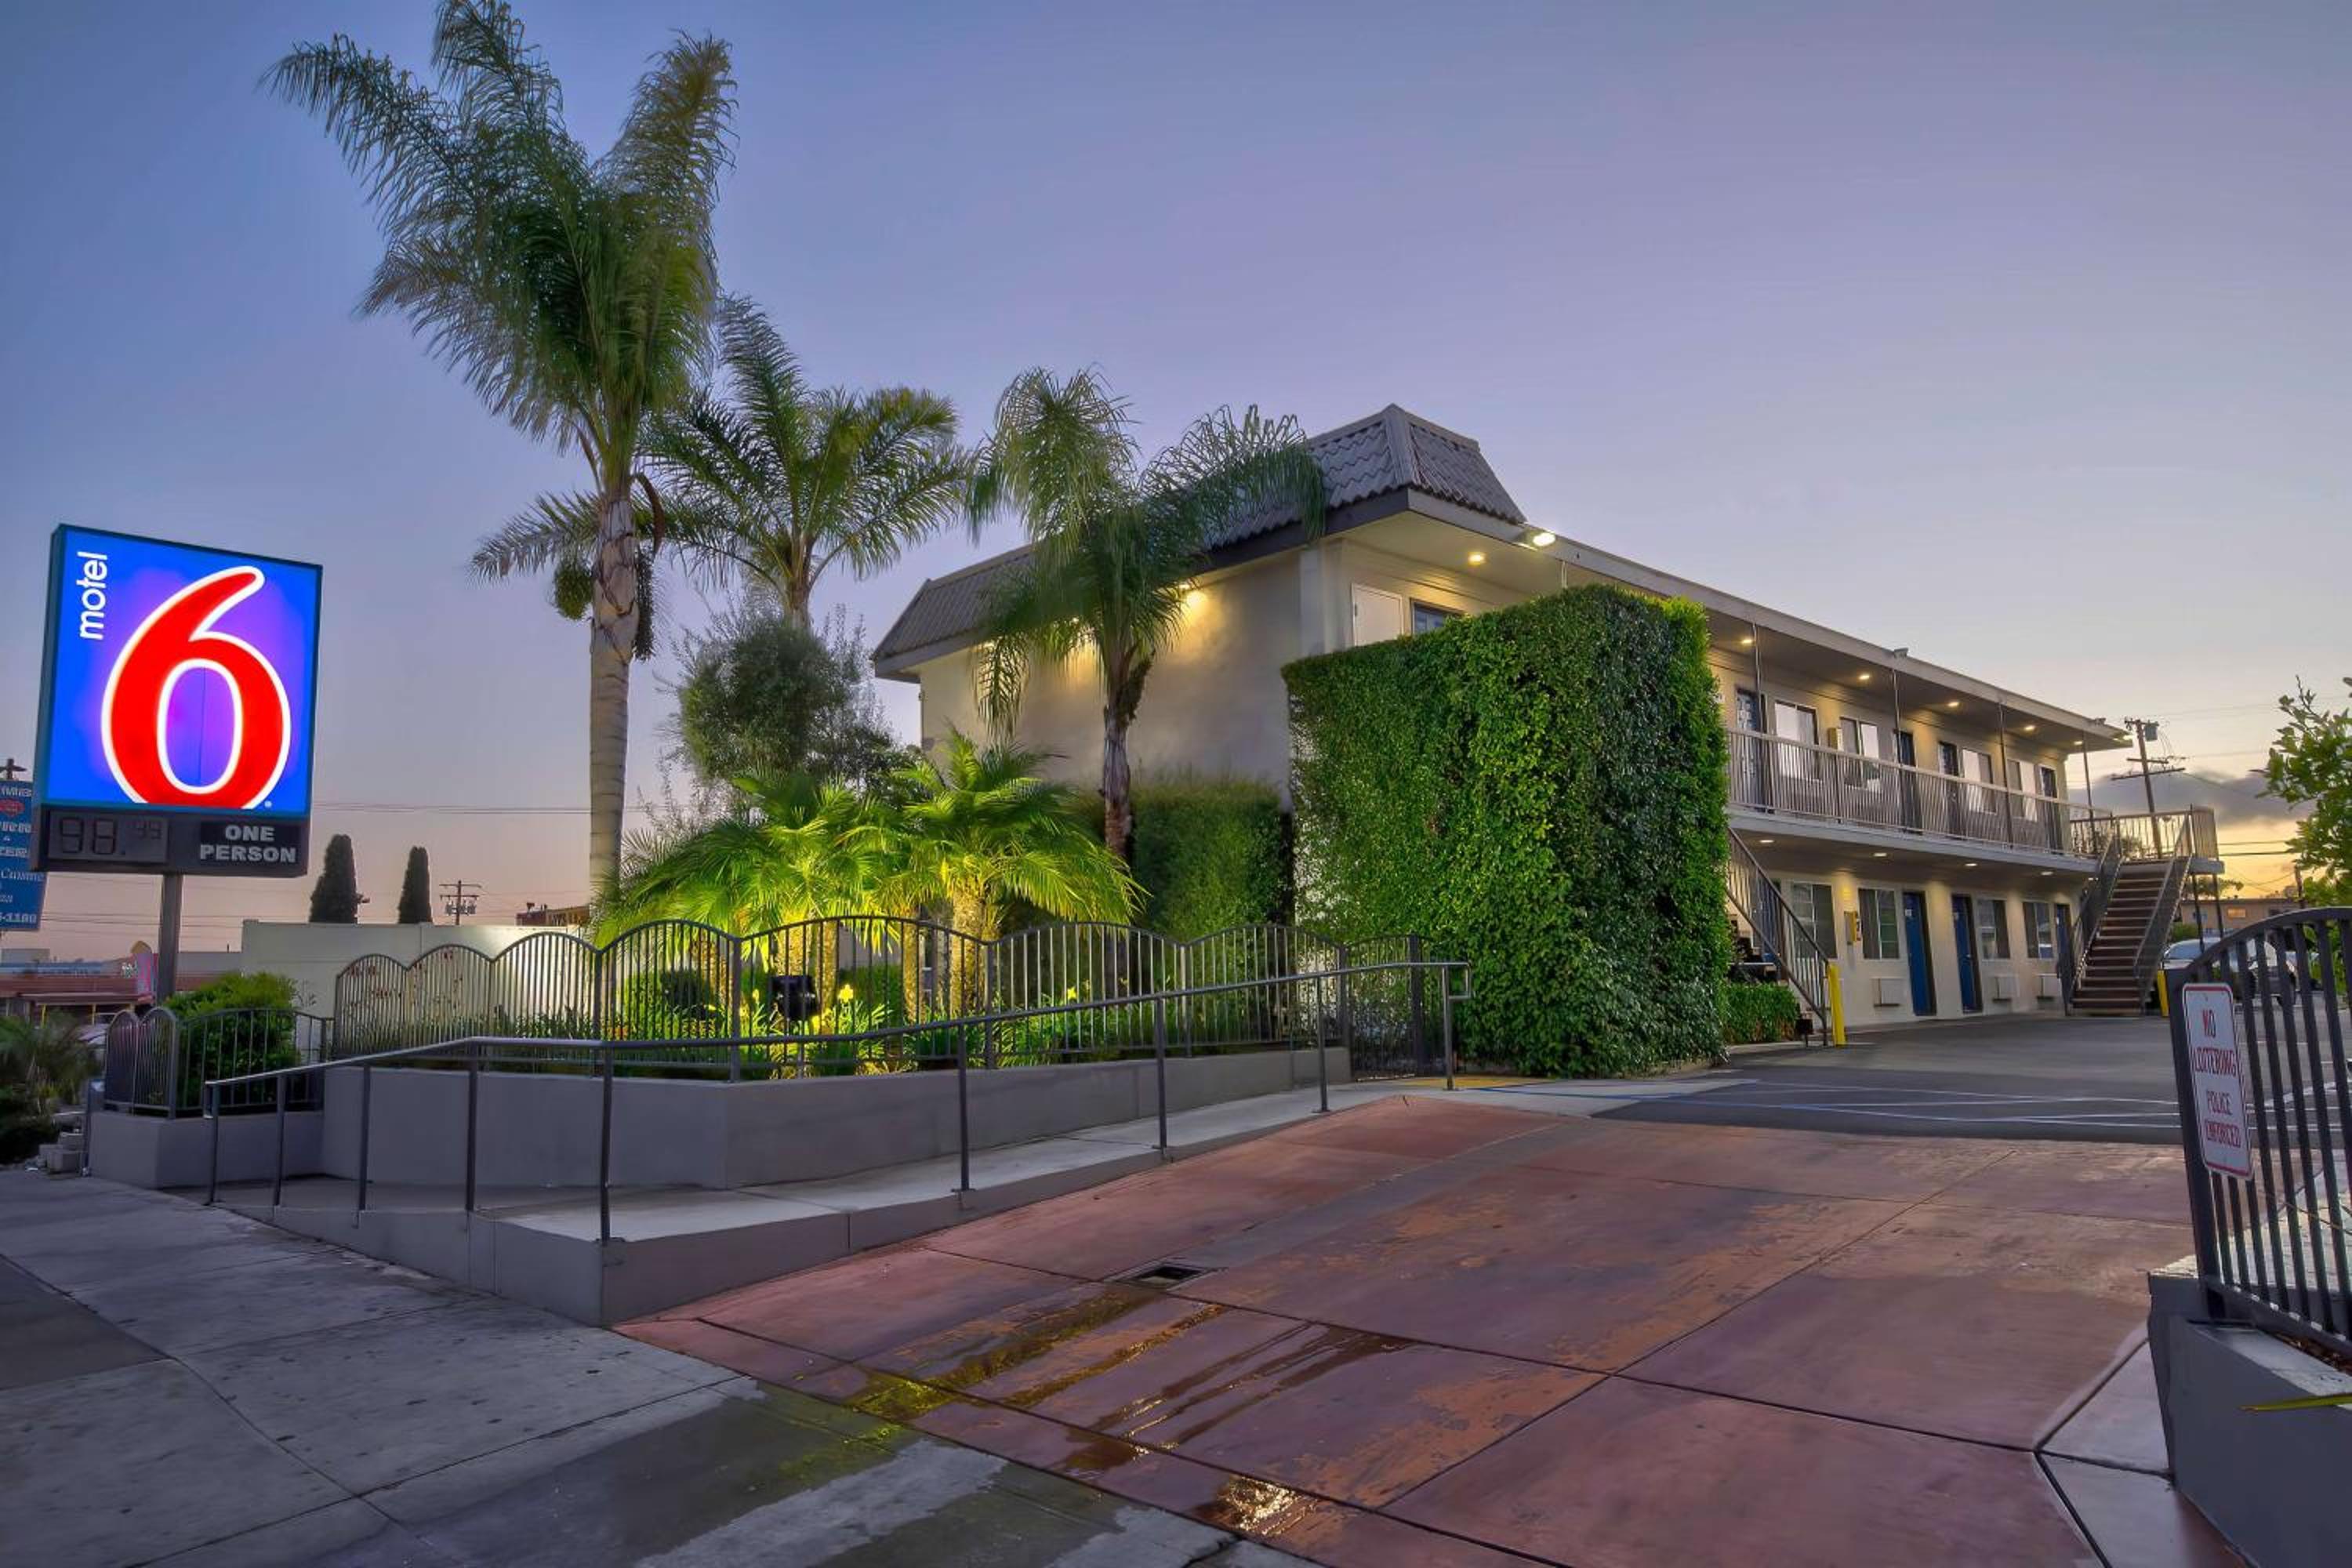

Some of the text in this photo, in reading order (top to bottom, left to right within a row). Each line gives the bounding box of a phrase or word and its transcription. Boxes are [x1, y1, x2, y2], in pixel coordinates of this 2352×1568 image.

[77, 551, 107, 641] motel
[101, 565, 292, 809] 6
[225, 825, 274, 841] ONE
[200, 844, 296, 862] PERSON
[2201, 1008, 2217, 1038] NO
[2194, 1047, 2237, 1077] LOITERING
[2205, 1090, 2233, 1116] POLICE
[2204, 1120, 2241, 1149] ENFORCED
